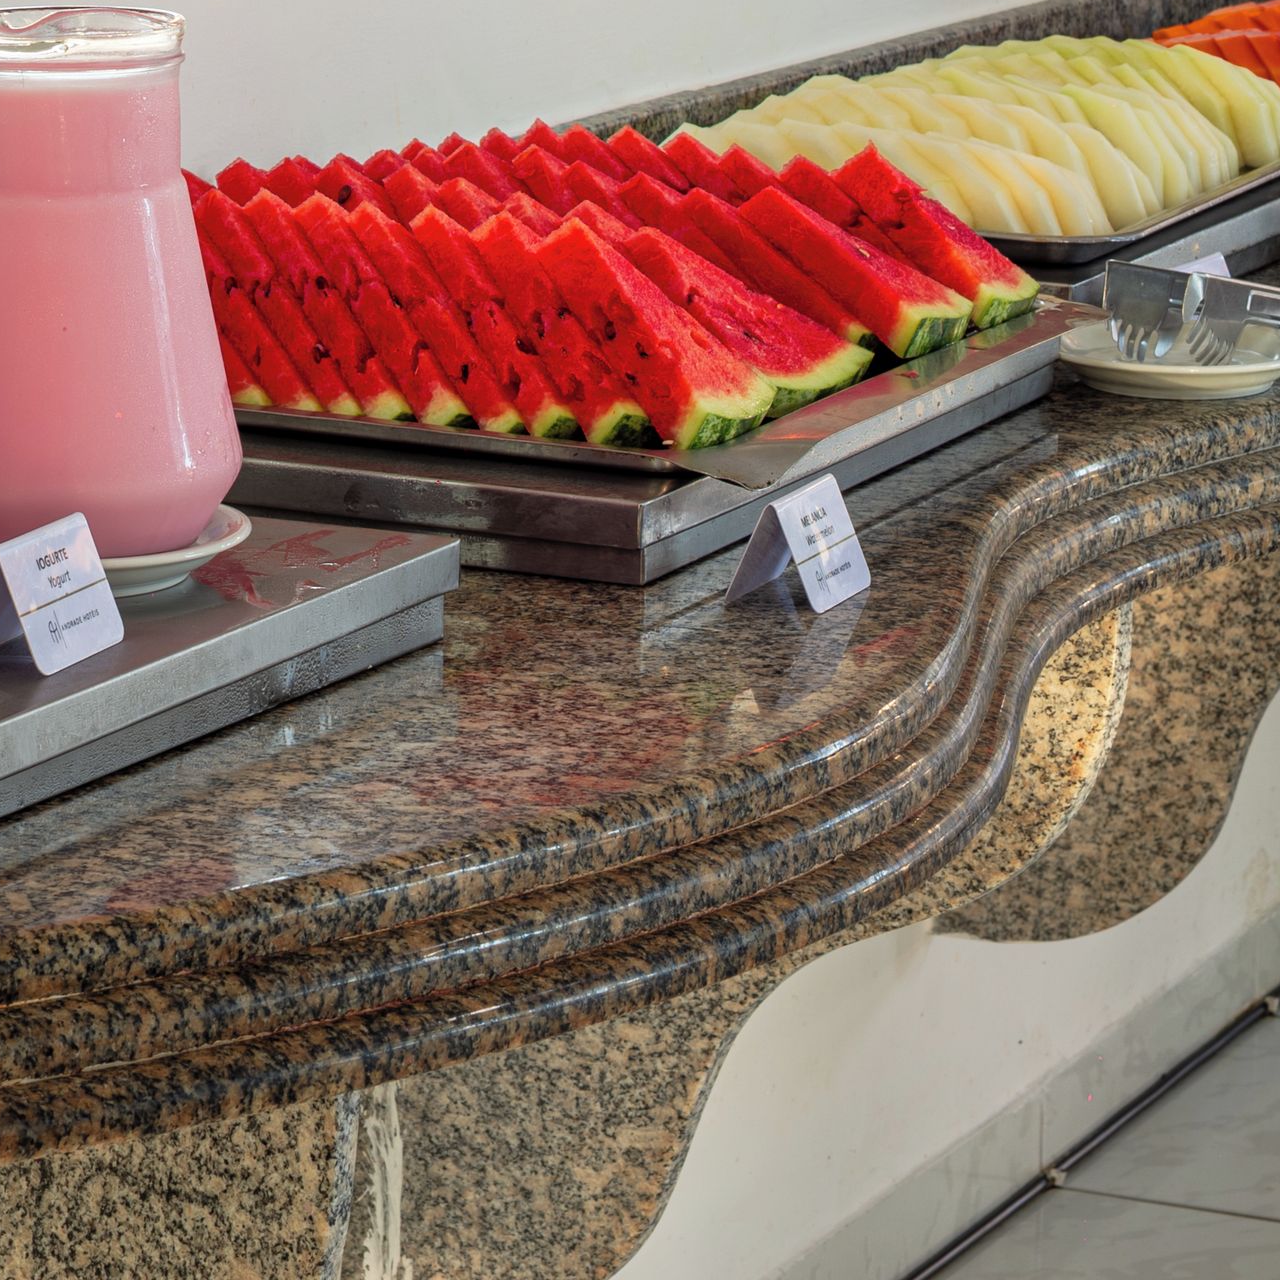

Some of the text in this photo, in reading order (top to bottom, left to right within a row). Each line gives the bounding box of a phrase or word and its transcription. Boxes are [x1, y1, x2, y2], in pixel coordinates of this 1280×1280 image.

[805, 525, 835, 547] Watmelon
[35, 547, 69, 571] IOGURTE
[47, 569, 71, 589] Yogurt
